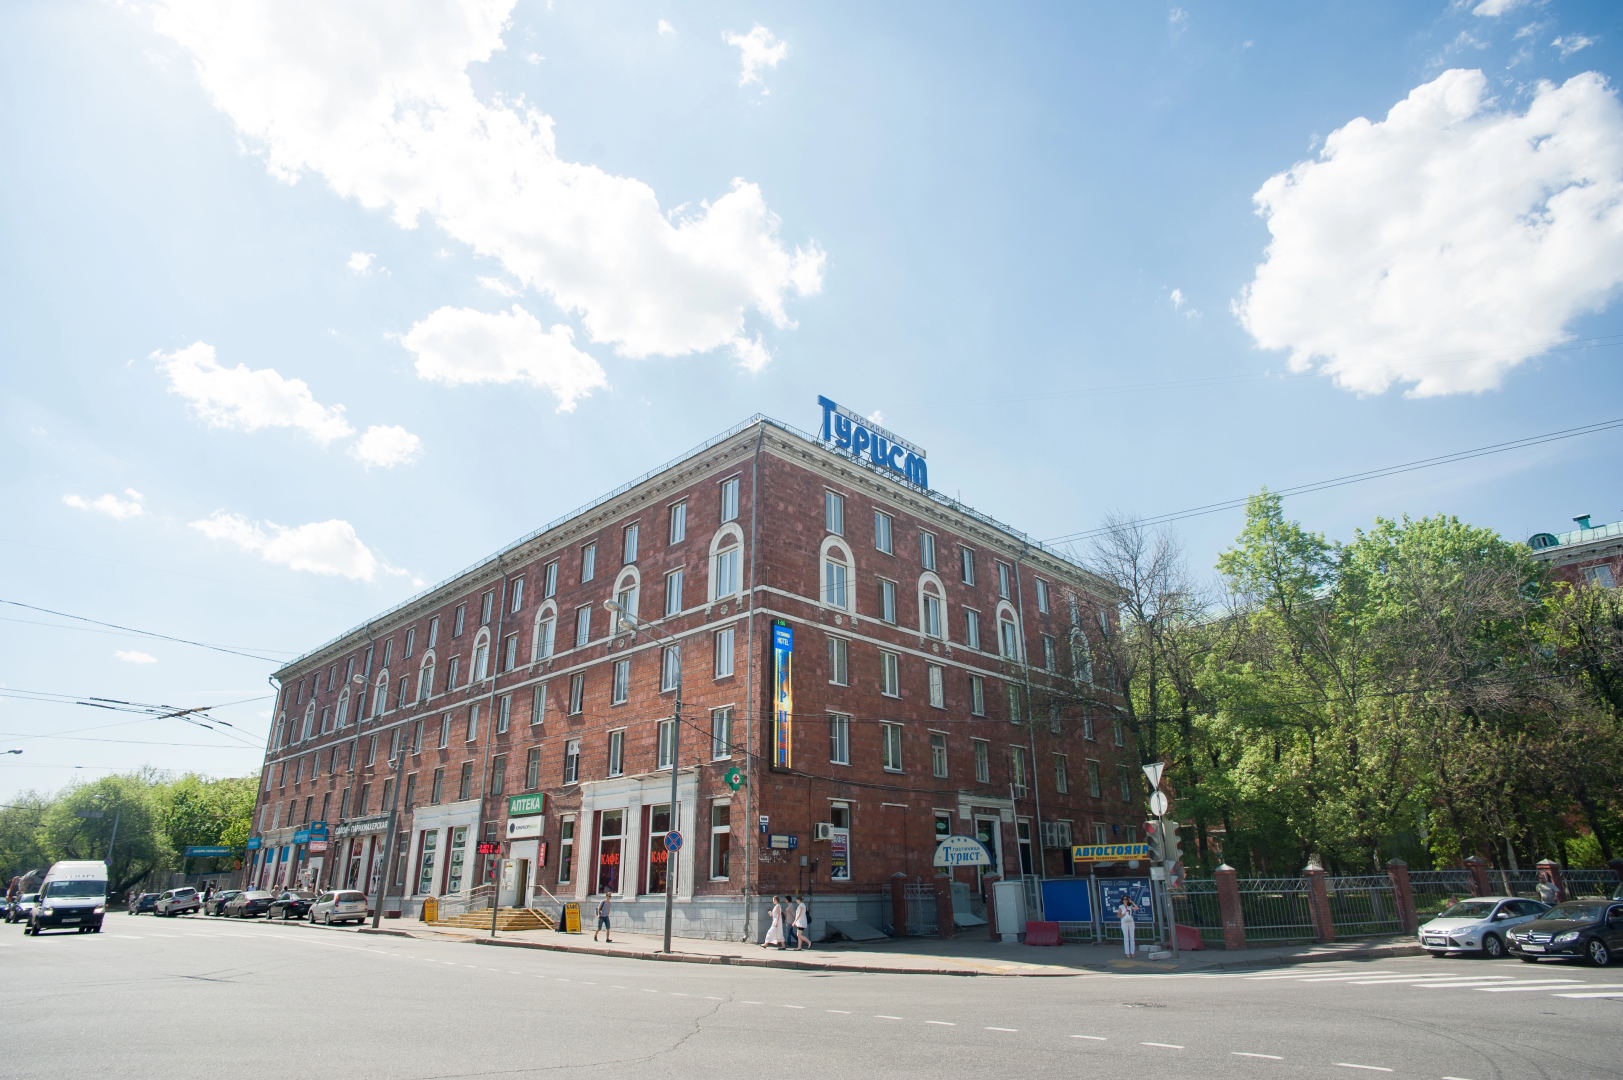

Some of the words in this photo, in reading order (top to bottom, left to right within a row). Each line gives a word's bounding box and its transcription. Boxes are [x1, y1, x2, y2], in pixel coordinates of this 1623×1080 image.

[848, 411, 896, 442] ГОСТИНИЦА
[510, 797, 540, 812] АПТЕКА
[350, 820, 389, 833] ПАРИКМАХЕРСКАЯ
[789, 837, 798, 845] 17
[942, 846, 980, 865] Турист
[1075, 845, 1150, 857] АВТОСТОЯНК
[600, 853, 620, 865] КАФЕ
